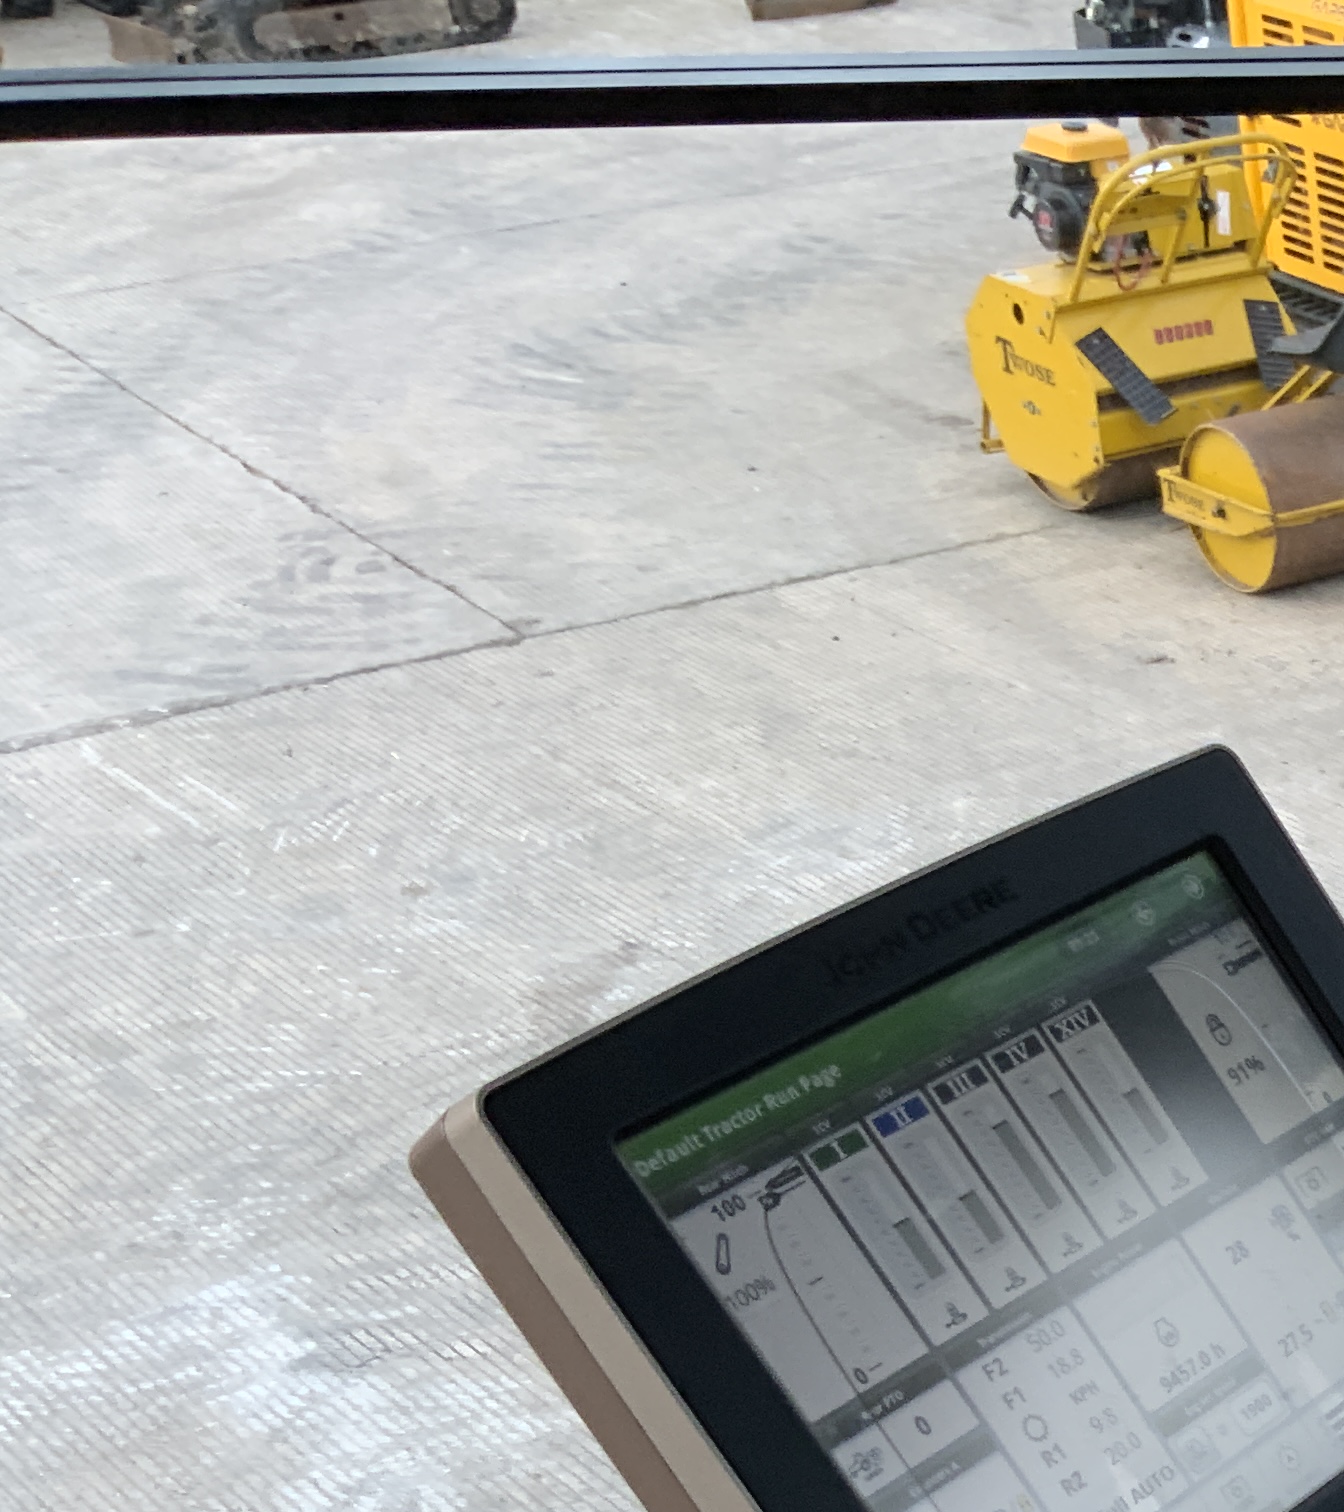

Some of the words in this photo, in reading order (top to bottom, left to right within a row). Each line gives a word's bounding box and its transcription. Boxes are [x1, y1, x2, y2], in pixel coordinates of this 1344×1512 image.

[1054, 1008, 1091, 1041] XIV
[1005, 1042, 1028, 1066] IV
[947, 1072, 975, 1098] III
[1226, 1055, 1266, 1086] 91%
[631, 1132, 706, 1178] Default
[698, 1103, 765, 1142] Tractor
[762, 1084, 801, 1112] Run
[797, 1064, 842, 1093] Page
[891, 1106, 914, 1127] II
[710, 1194, 747, 1222] 100
[980, 1356, 1009, 1383] F2
[1025, 1319, 1066, 1354] 50.0
[1001, 1385, 1027, 1411] F1
[1047, 1347, 1086, 1380] 18.8
[1158, 1350, 1212, 1394] 9457.0
[1209, 1341, 1227, 1359] h
[913, 1414, 933, 1436] 0
[1039, 1442, 1068, 1469] R1
[1059, 1470, 1088, 1498] R2
[1103, 1431, 1143, 1467] 20.0
[1129, 1464, 1176, 1506] AUTO
